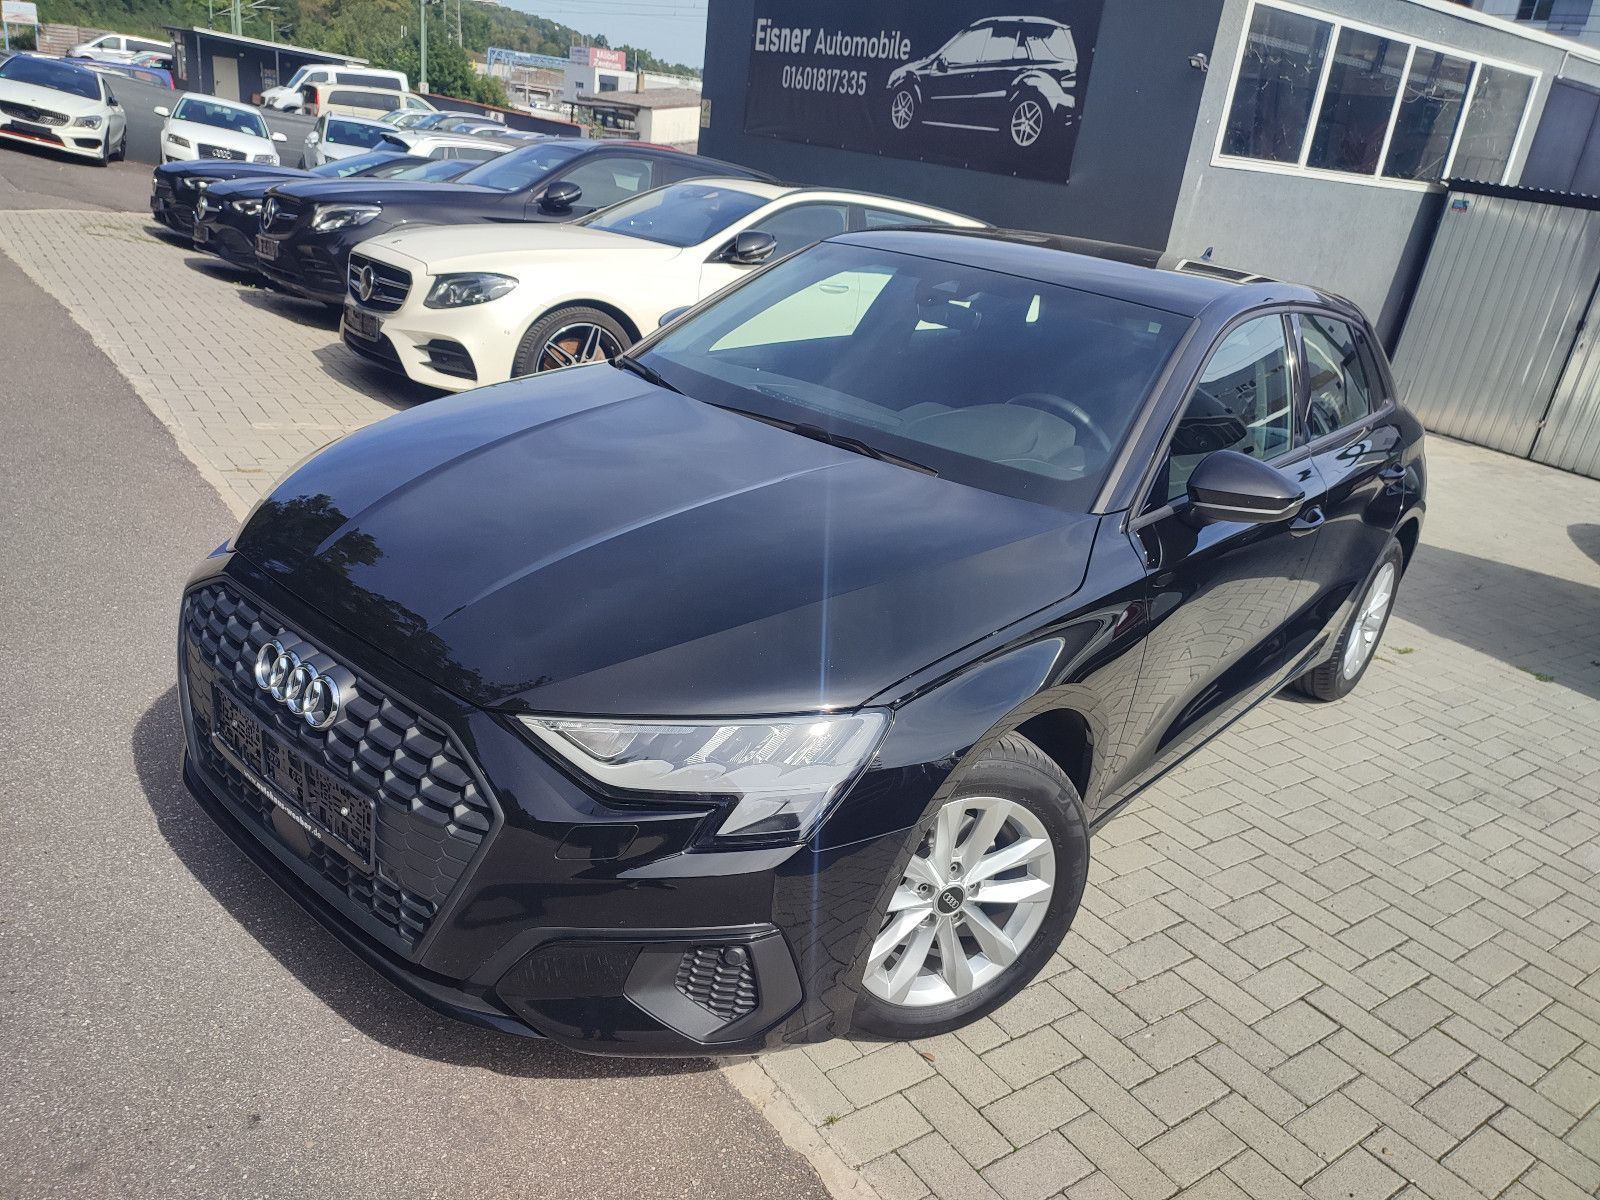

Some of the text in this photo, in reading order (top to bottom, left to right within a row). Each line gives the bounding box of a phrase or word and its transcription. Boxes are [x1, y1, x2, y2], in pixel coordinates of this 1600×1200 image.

[755, 18, 911, 60] Eisner Automobile
[782, 65, 867, 96] 01601817335
